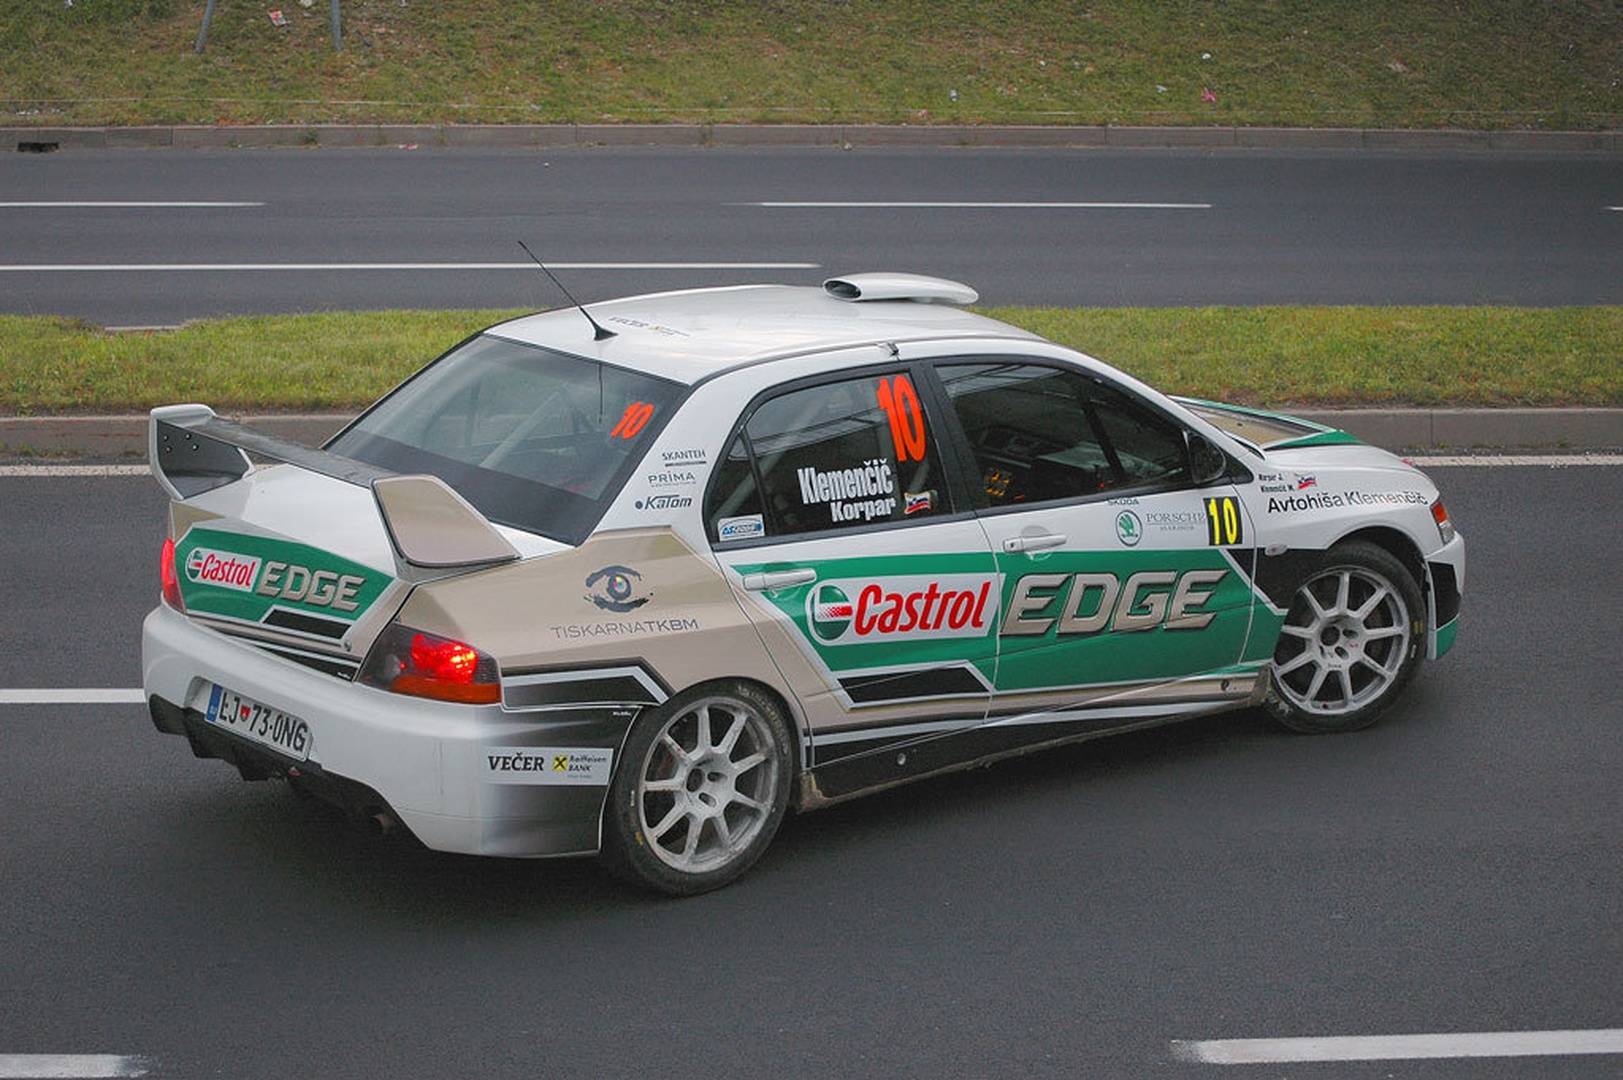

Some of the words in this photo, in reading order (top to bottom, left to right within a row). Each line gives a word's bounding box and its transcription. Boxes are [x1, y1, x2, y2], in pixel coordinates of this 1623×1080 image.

[610, 401, 655, 440] 10
[876, 374, 926, 462] 10
[797, 458, 894, 504] Klemenčič
[1267, 492, 1344, 514] Avtohiša
[830, 497, 896, 522] Korpar
[1209, 497, 1237, 545] 10
[201, 553, 256, 587] Castrol
[256, 560, 366, 613] EDGE
[853, 580, 992, 636] Castrol
[999, 568, 1231, 639] EDGE
[487, 751, 545, 771] VEČER
